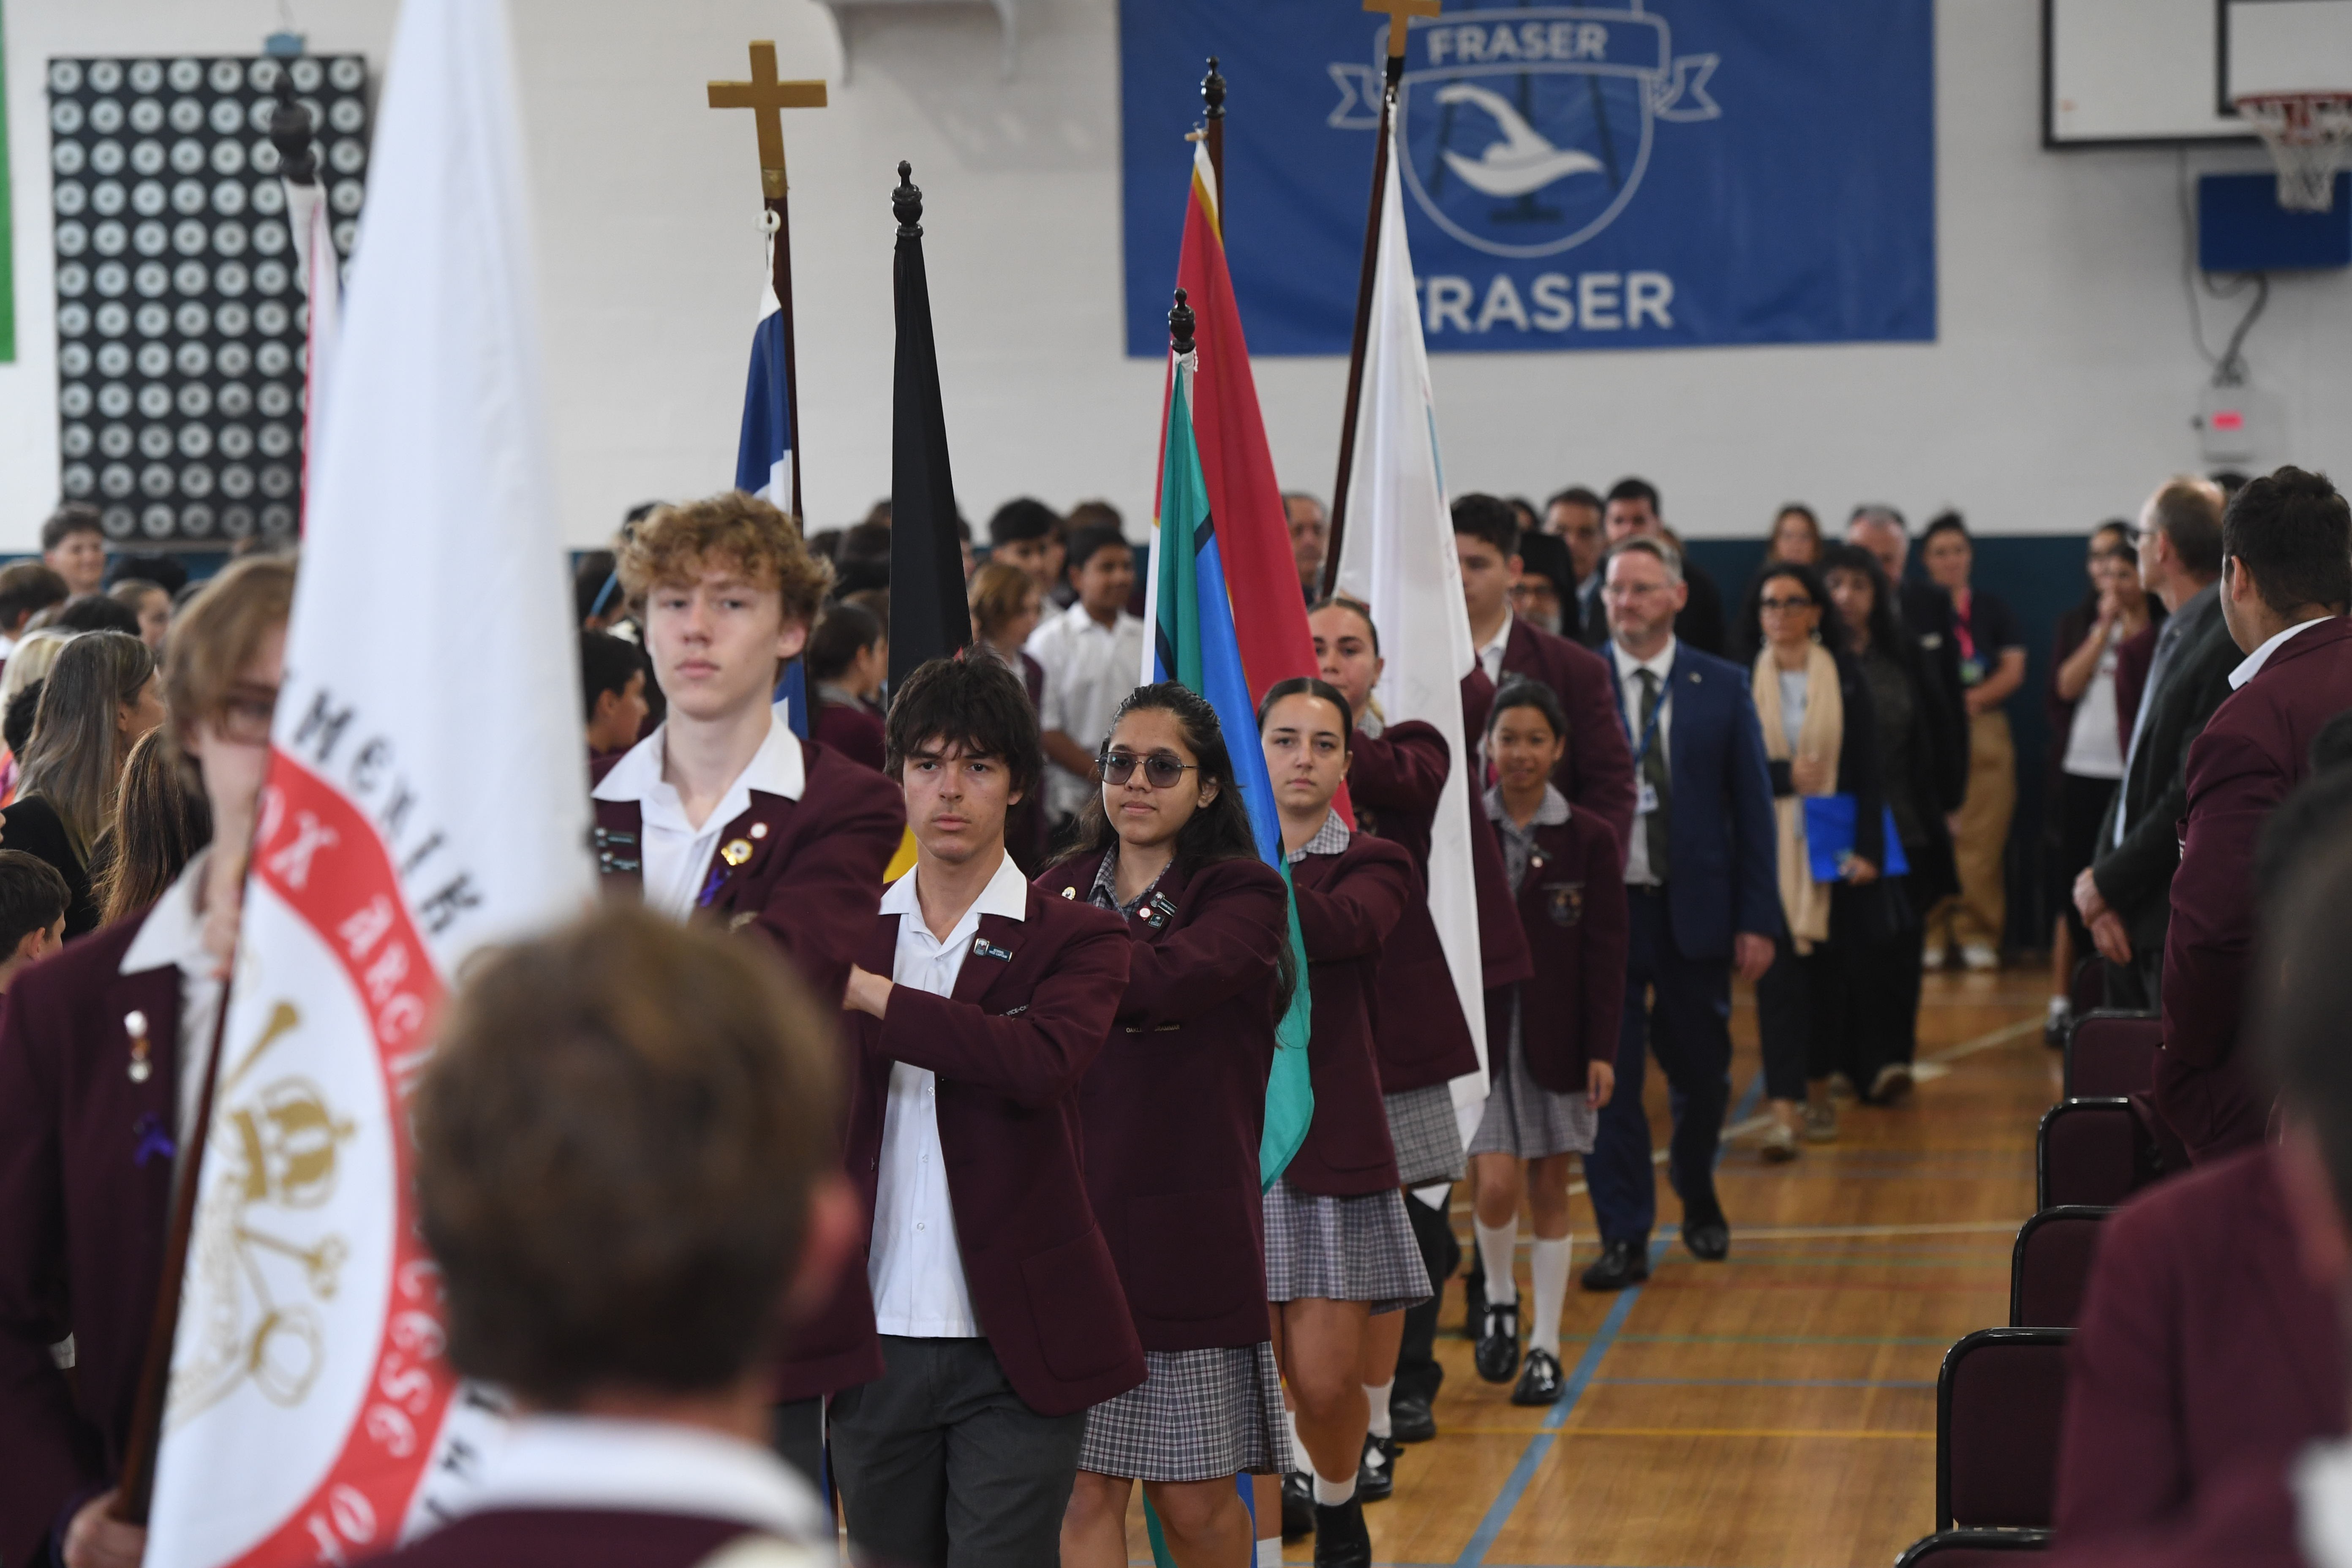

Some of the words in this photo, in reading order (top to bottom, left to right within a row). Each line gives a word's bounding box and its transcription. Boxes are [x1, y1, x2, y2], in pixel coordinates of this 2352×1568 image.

[1428, 23, 1608, 65] FRASER
[1413, 271, 1675, 334] RASER
[1006, 1004, 1029, 1016] VICE-CA
